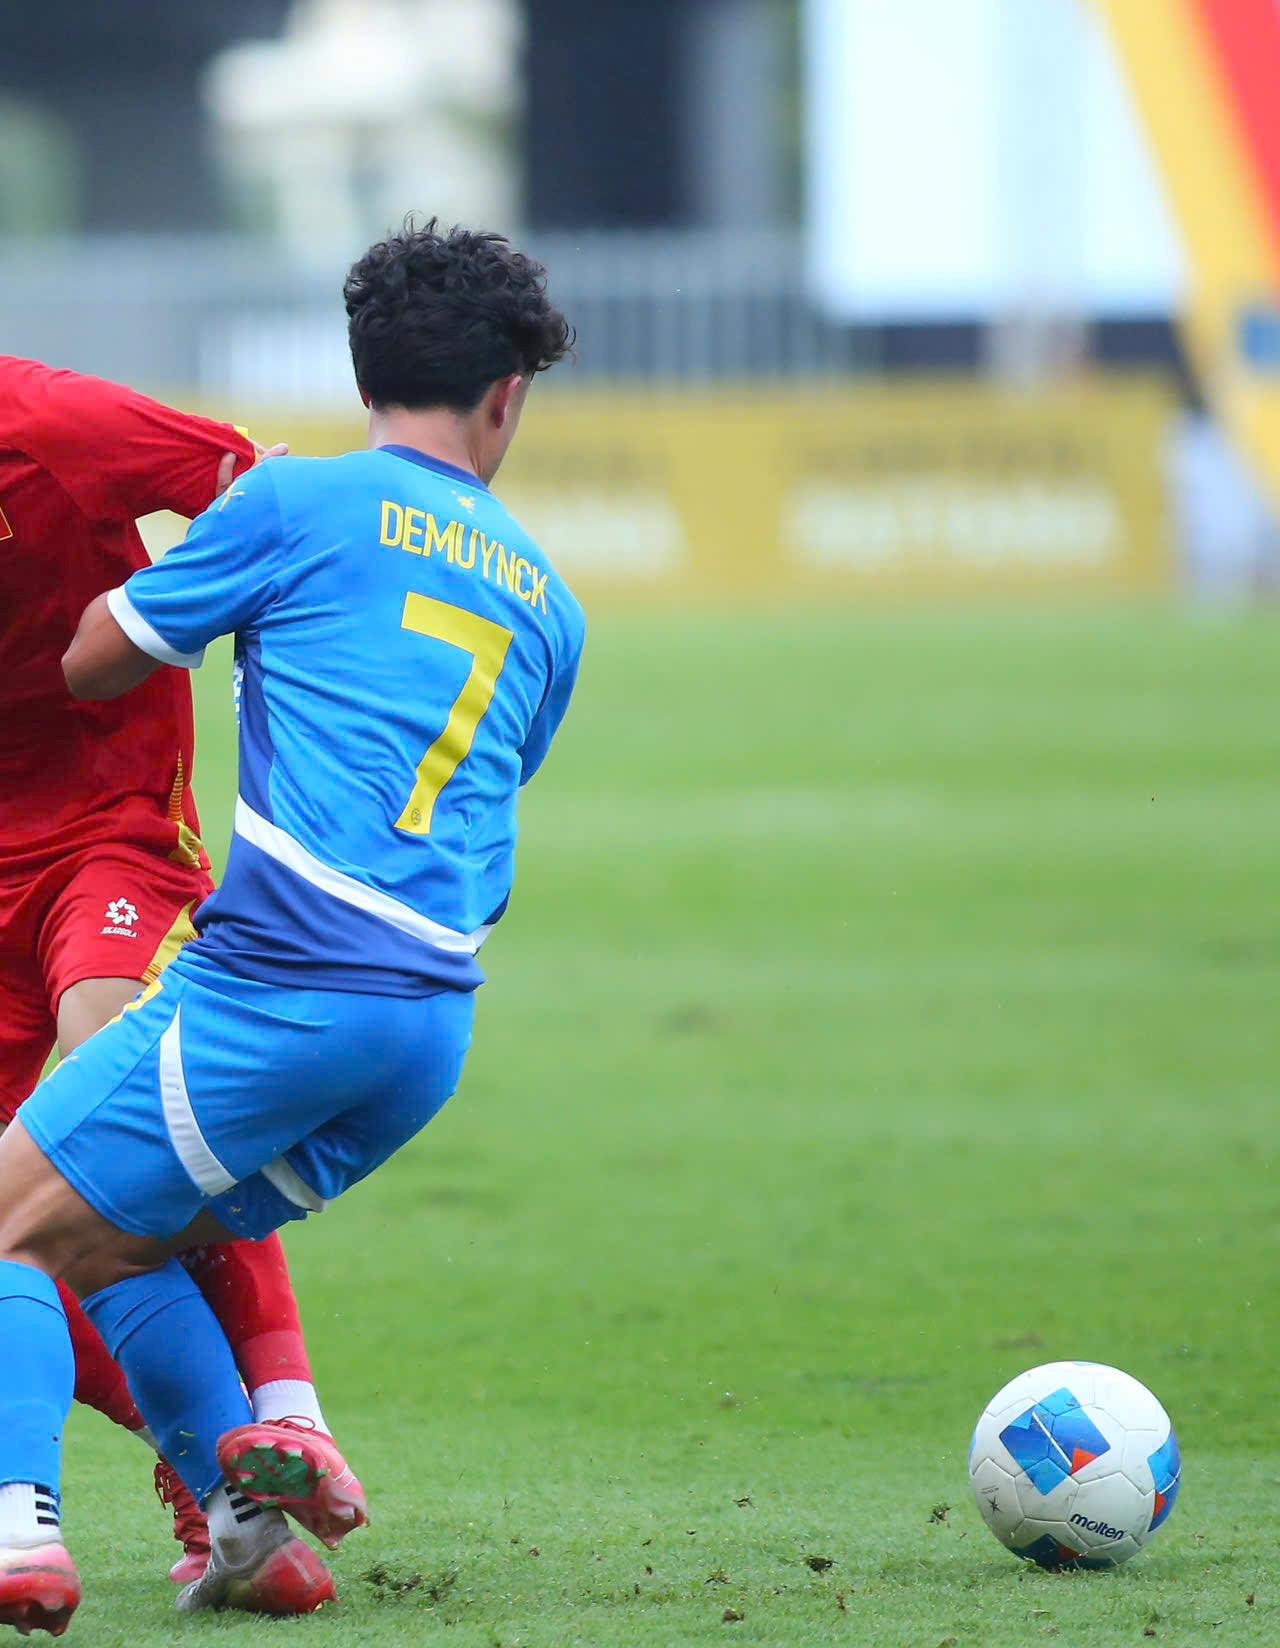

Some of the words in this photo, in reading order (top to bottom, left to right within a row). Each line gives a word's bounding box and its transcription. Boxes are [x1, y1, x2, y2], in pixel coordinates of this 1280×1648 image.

[379, 499, 550, 616] DEMUYNCK
[393, 591, 514, 835] 7
[1070, 1513, 1125, 1541] molten
